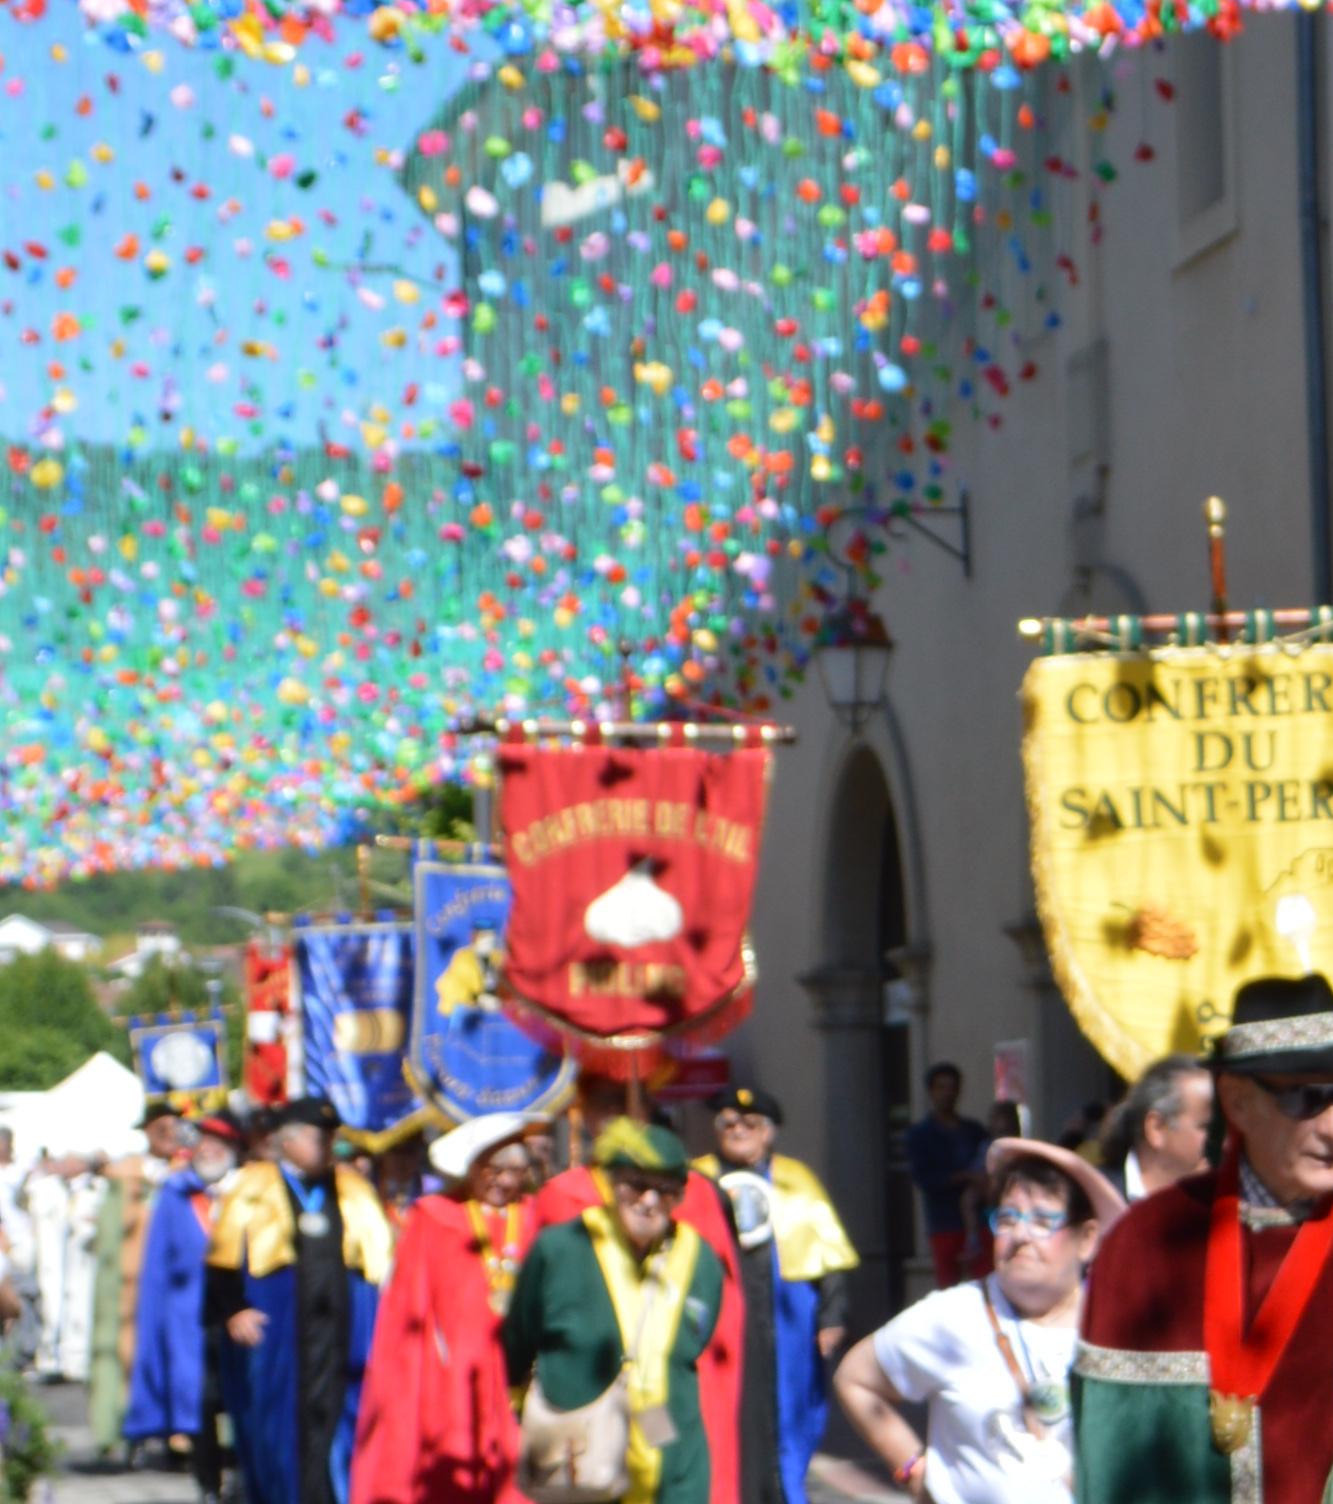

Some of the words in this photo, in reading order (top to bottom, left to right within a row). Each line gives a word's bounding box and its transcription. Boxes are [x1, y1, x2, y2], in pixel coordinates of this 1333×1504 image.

[1191, 729, 1278, 773] DU
[510, 797, 649, 867] CONFRERIE
[654, 800, 692, 838] DE
